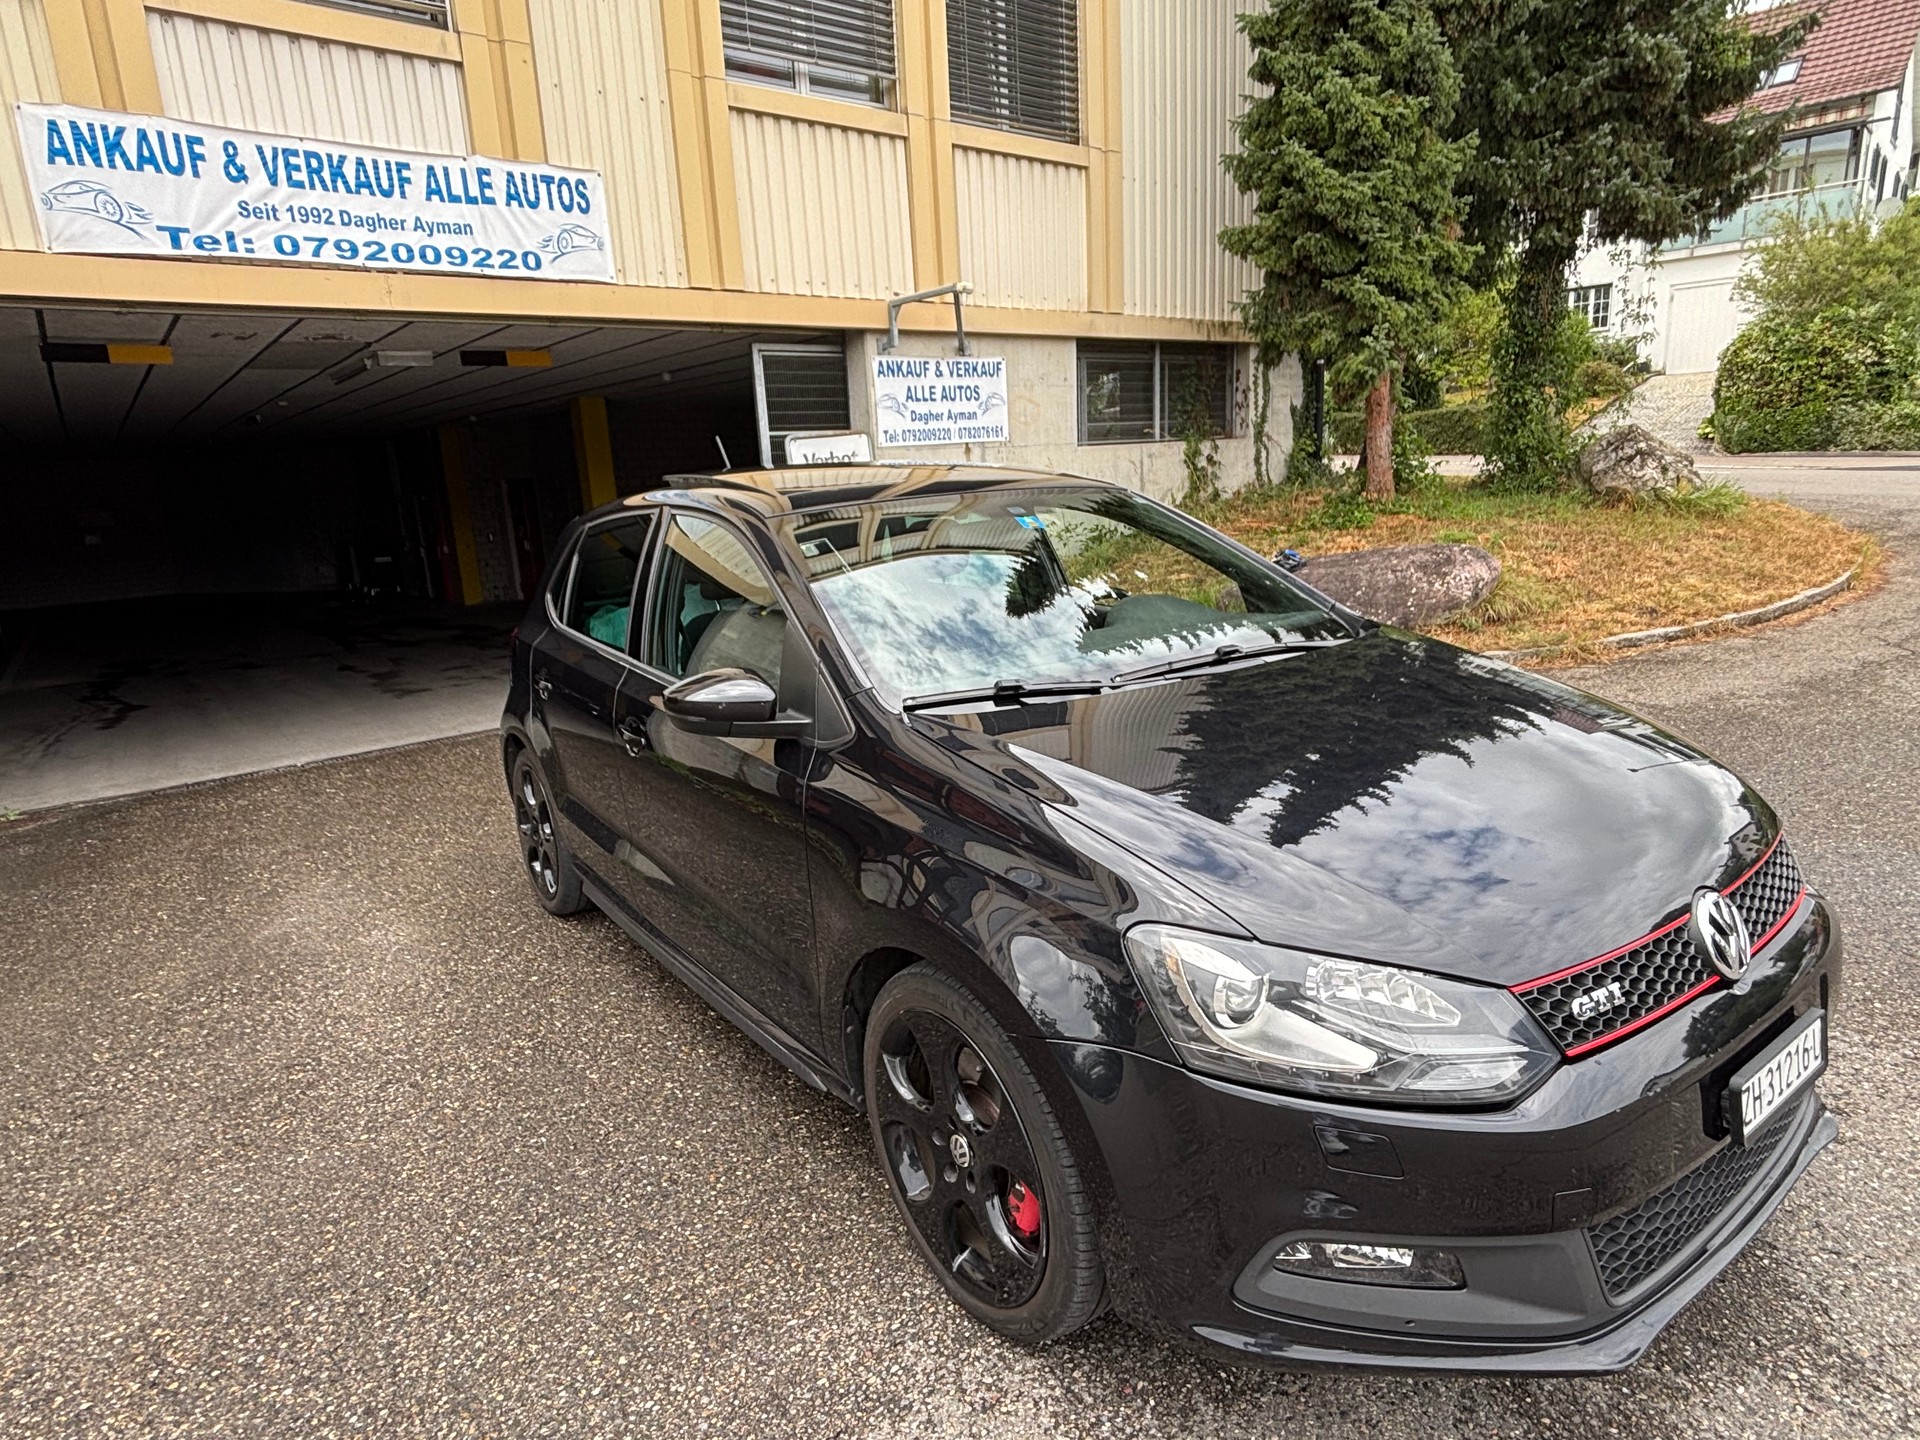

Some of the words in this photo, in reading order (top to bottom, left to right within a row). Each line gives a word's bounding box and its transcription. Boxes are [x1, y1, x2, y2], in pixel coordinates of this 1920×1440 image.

[46, 118, 207, 179] ANKAUF
[222, 139, 250, 185] &
[254, 143, 412, 200] VERKAUF
[425, 164, 497, 205] ALLE
[505, 170, 591, 215] AUTOS
[237, 199, 280, 222] Seit
[285, 204, 336, 226] 1992
[339, 209, 407, 234] Dagher
[413, 215, 474, 238] Ayman
[155, 224, 256, 254] Tel:
[273, 234, 543, 272] 0792009220
[877, 360, 930, 378] ANKAUF
[934, 360, 944, 378] &
[946, 360, 1003, 378] VERKAUF
[905, 385, 937, 402] ALLE
[940, 384, 981, 402] AUTOS
[910, 409, 944, 425] Dagher
[946, 409, 978, 424] Ayman
[883, 429, 900, 443] Tel:
[901, 427, 952, 442] 0792009220
[957, 425, 1004, 440] 0782076161
[1571, 981, 1626, 1021] GTI
